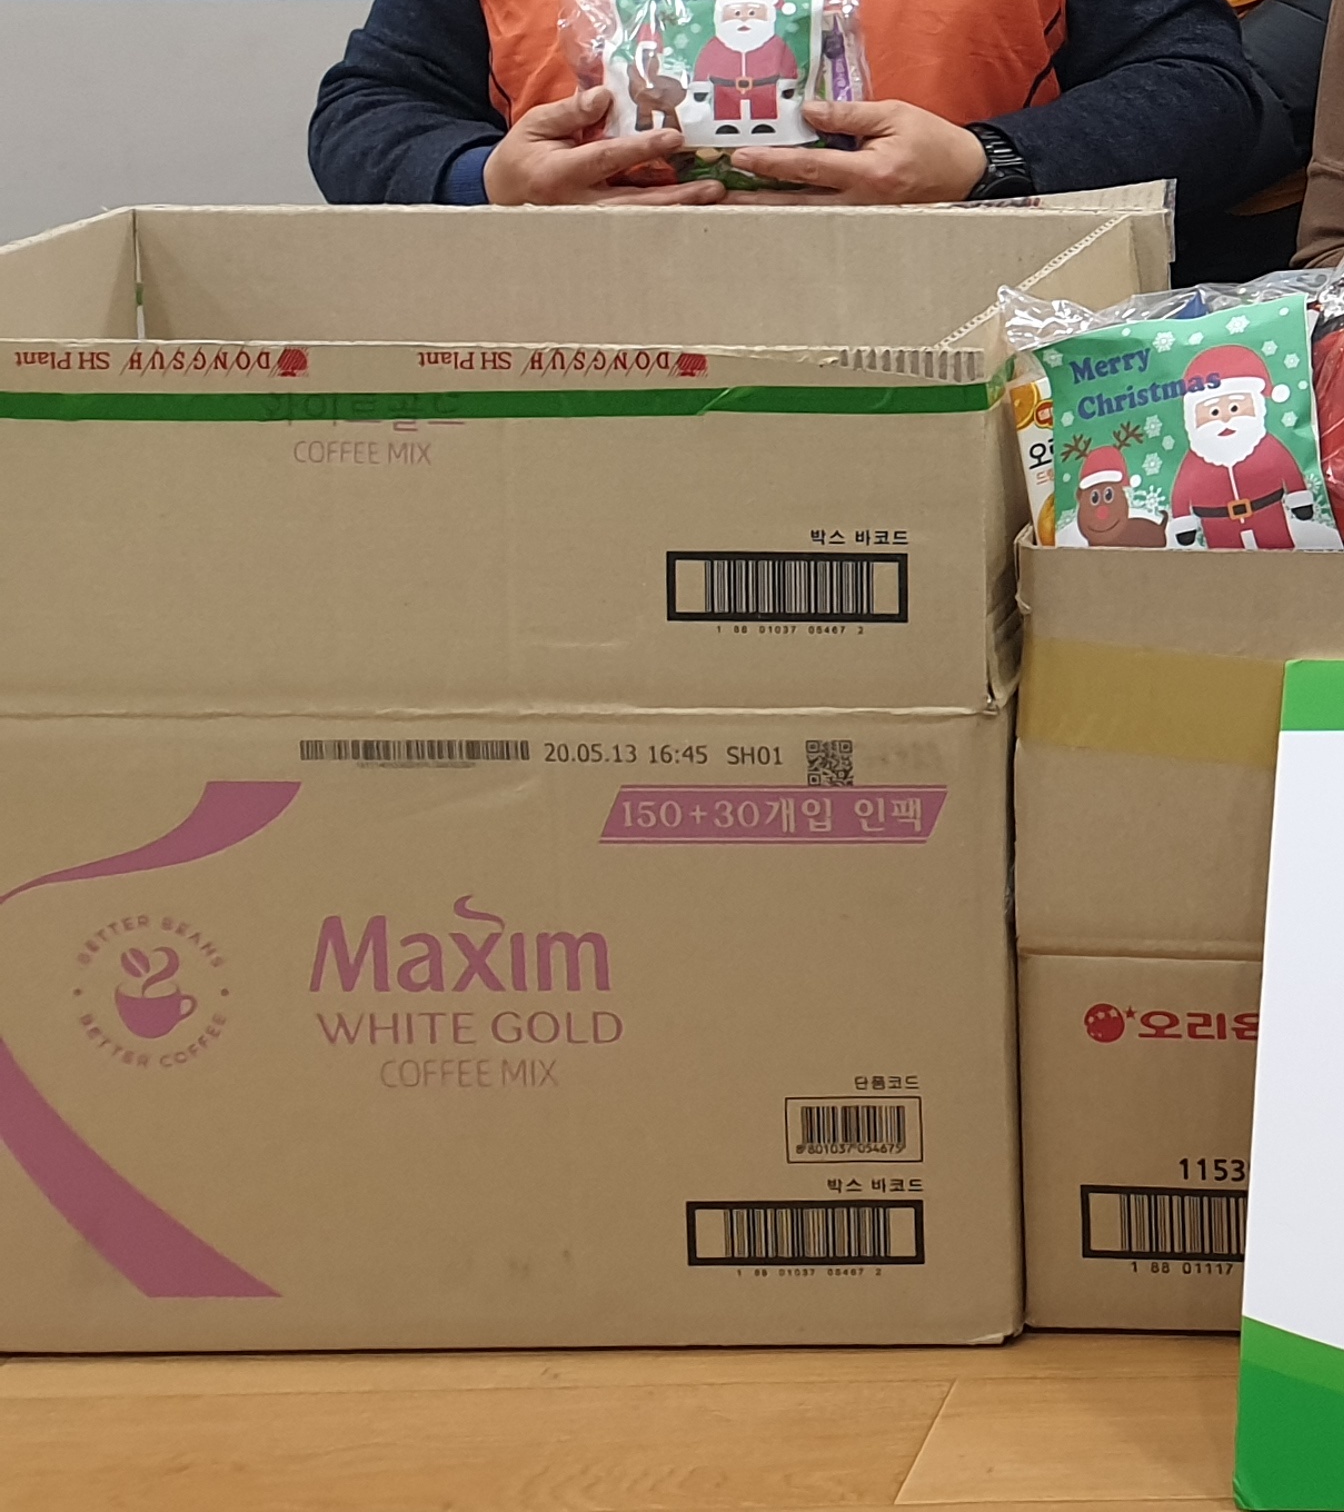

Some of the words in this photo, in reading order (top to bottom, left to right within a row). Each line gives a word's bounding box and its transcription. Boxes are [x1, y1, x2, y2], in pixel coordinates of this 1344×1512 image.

[1070, 346, 1151, 385] Merry
[1077, 372, 1222, 420] Christmas
[293, 440, 379, 465] COFFEE
[387, 442, 432, 465] MIX
[810, 529, 847, 546] 박스
[854, 530, 909, 546] 바코드
[544, 741, 637, 766] 20.05.13
[648, 741, 709, 765] 16:45
[727, 743, 783, 767] SH01
[619, 795, 834, 834] 150+30개입
[854, 797, 925, 833] 인팩
[309, 895, 612, 993] Maxim
[158, 1011, 228, 1068] COFFEE
[316, 1011, 477, 1045] WHITE
[490, 1010, 624, 1045] GOLD
[380, 1058, 492, 1088] COFFEE
[501, 1059, 560, 1087] MIX
[854, 1075, 921, 1091] 단품코드
[1178, 1157, 1251, 1182] 1153
[827, 1178, 864, 1194] 박스
[871, 1177, 925, 1193] 바코드
